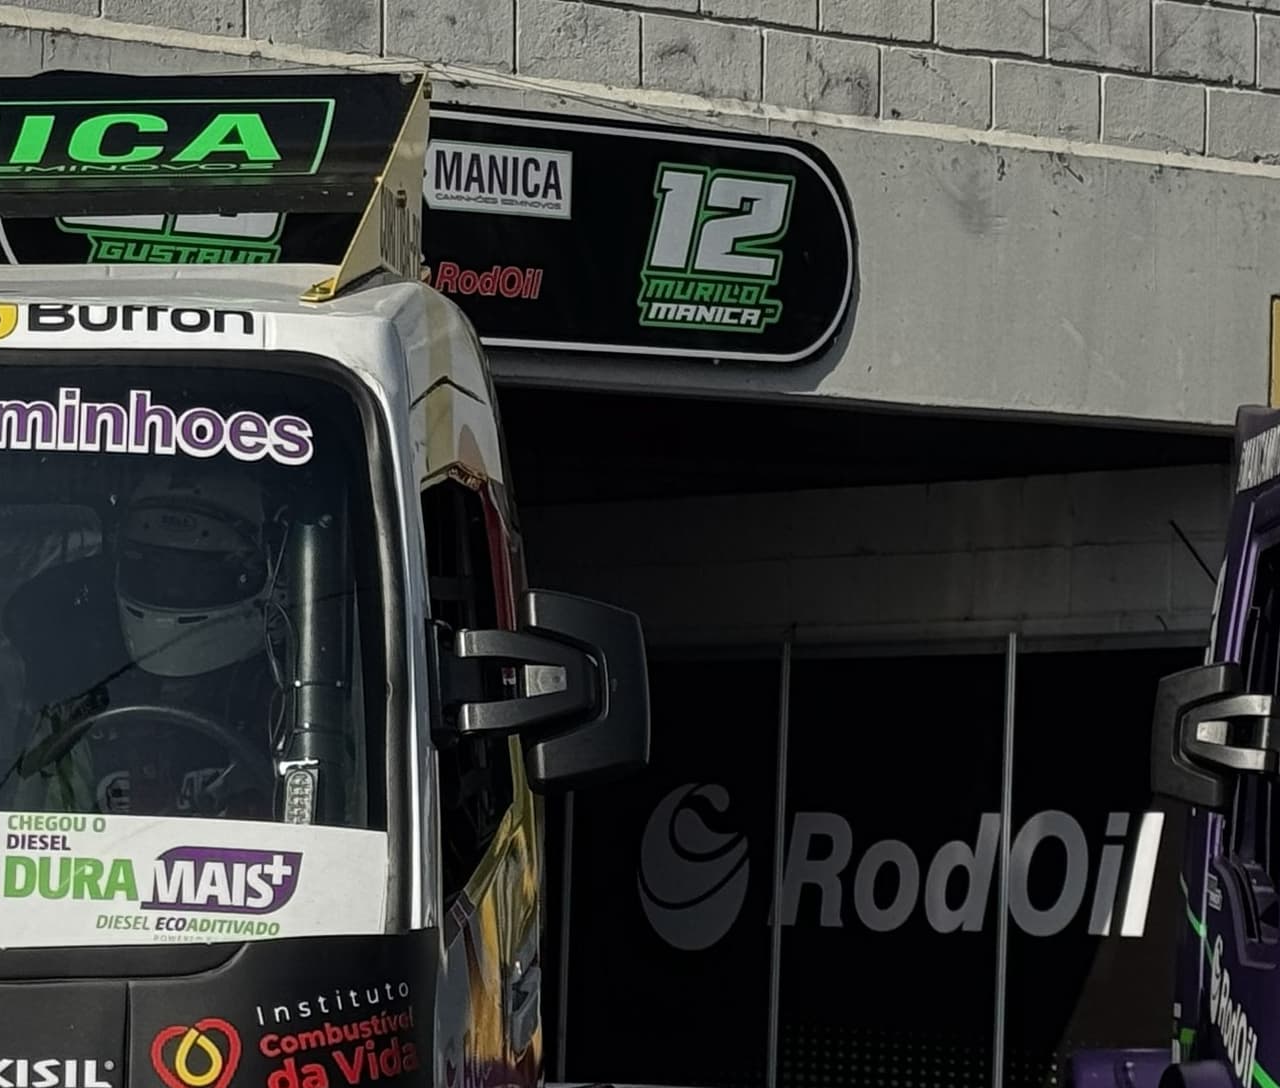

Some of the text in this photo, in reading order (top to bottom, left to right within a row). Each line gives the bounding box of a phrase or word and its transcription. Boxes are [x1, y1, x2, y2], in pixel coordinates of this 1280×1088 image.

[434, 149, 563, 201] MANICA
[649, 169, 789, 276] 12
[434, 261, 544, 300] RodOil
[645, 278, 762, 305] MURILO
[647, 303, 762, 327] MANICA
[6, 814, 107, 834] CHEGOU O
[6, 834, 72, 852] DIESEL
[3, 855, 140, 901] DURA
[767, 809, 1165, 938] RodOil
[95, 914, 282, 937] DIESEL ECOADITIVADO
[255, 980, 410, 1026] Instituto
[332, 1040, 418, 1086] Vida
